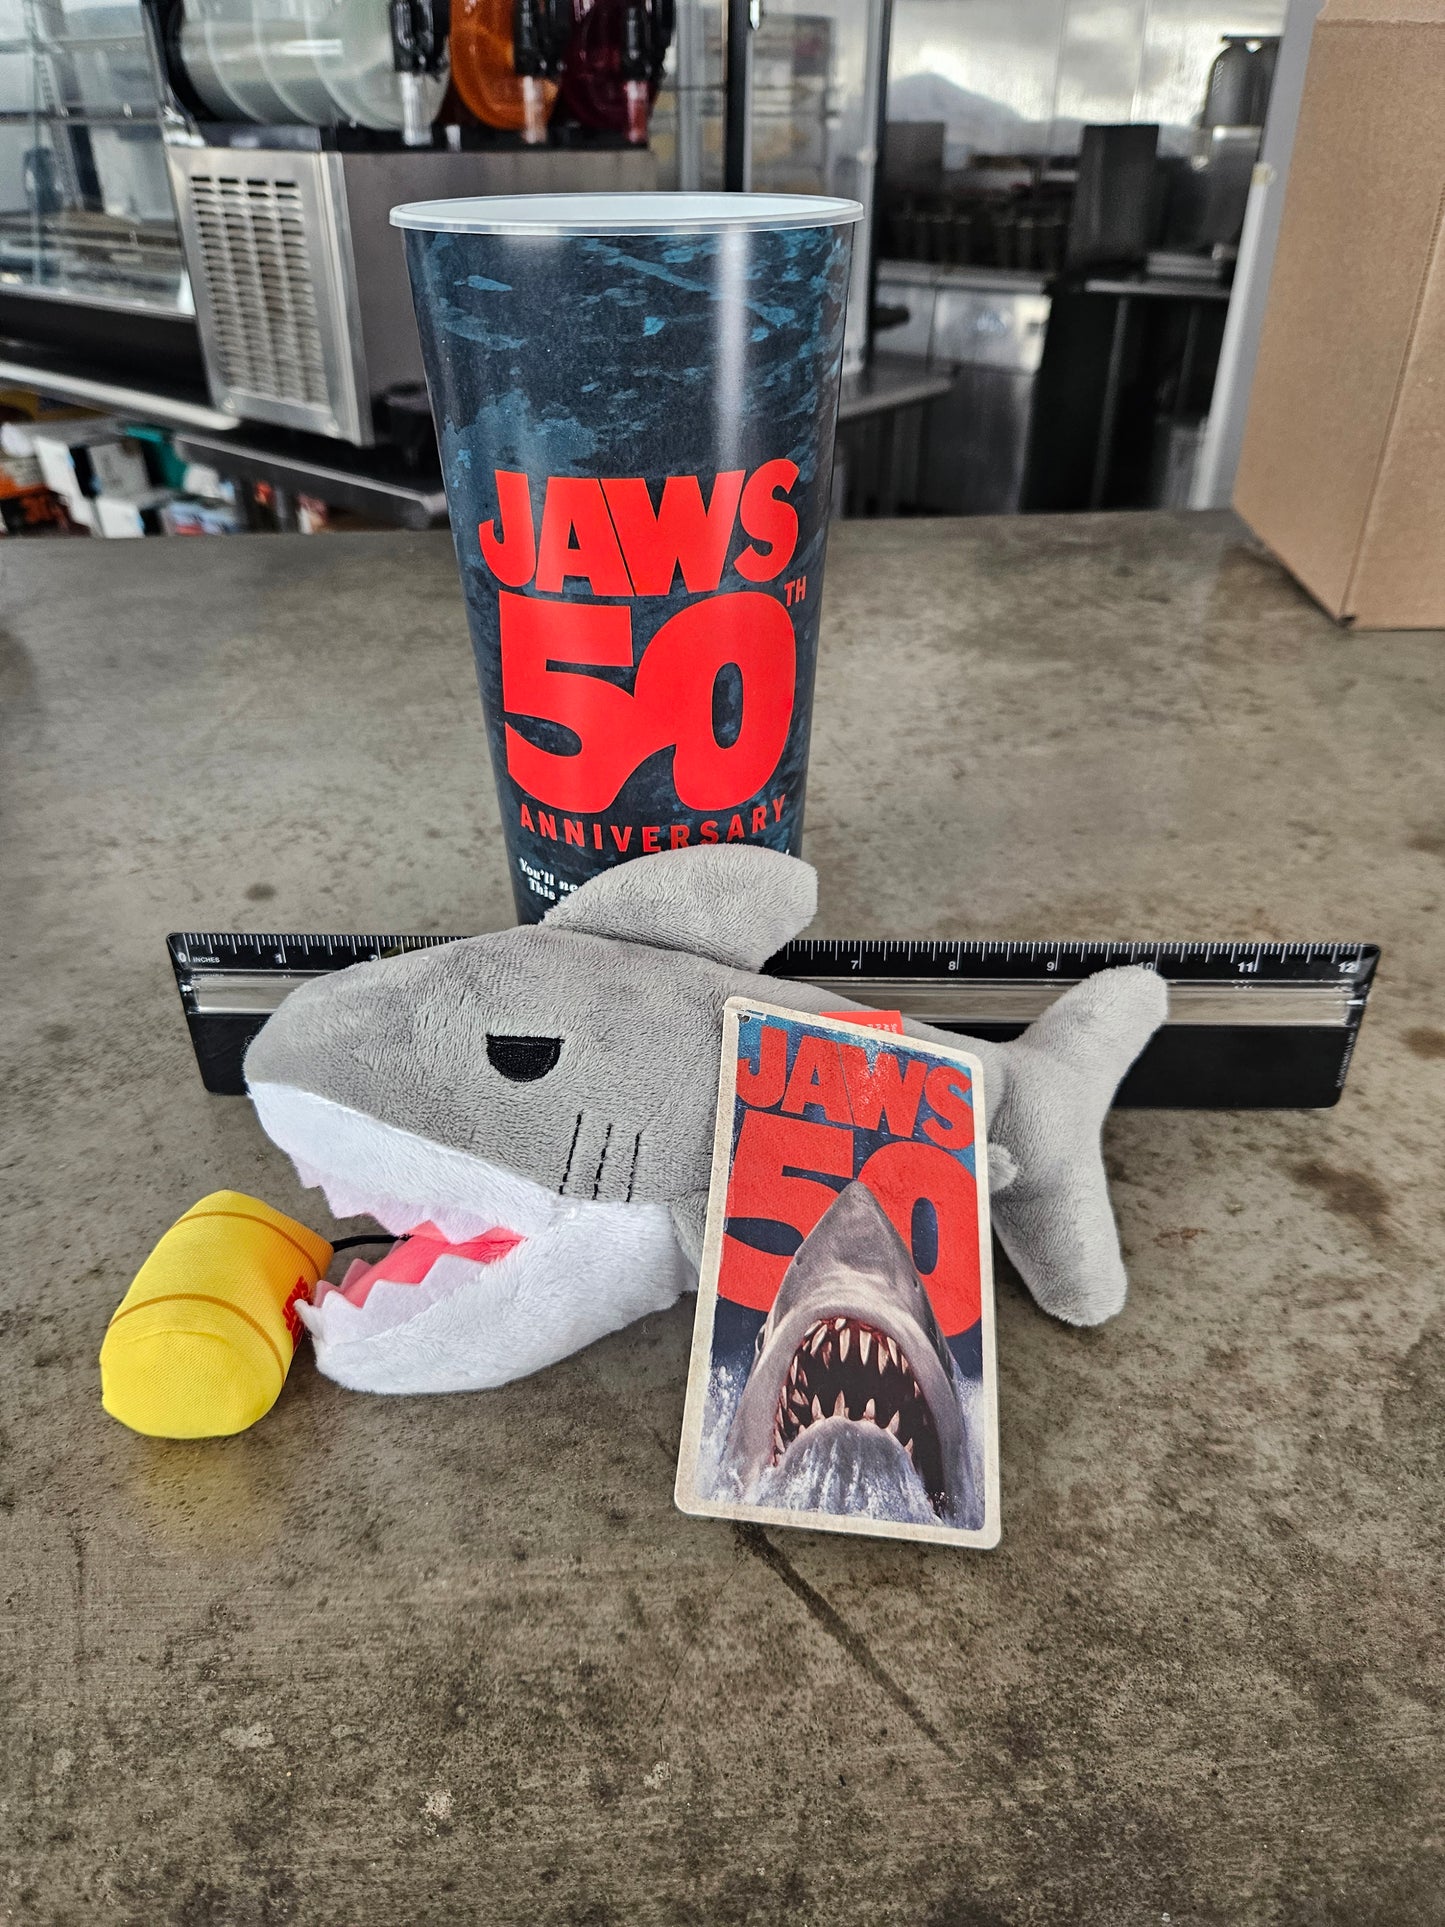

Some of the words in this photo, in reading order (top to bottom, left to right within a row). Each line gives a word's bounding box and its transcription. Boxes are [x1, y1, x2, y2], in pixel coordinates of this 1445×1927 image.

[478, 458, 800, 597] JAWS
[499, 590, 797, 814] 50
[784, 575, 806, 607] TH
[519, 793, 786, 853] ANNIVERSARY
[519, 857, 554, 886] You'll
[528, 876, 556, 901] This
[851, 960, 858, 970] 7
[948, 961, 956, 971] 8
[1046, 961, 1054, 971] 9
[1237, 961, 1253, 973] 11
[1337, 962, 1358, 973] 12
[736, 1026, 975, 1150] JAWS
[717, 1109, 982, 1338] 50
